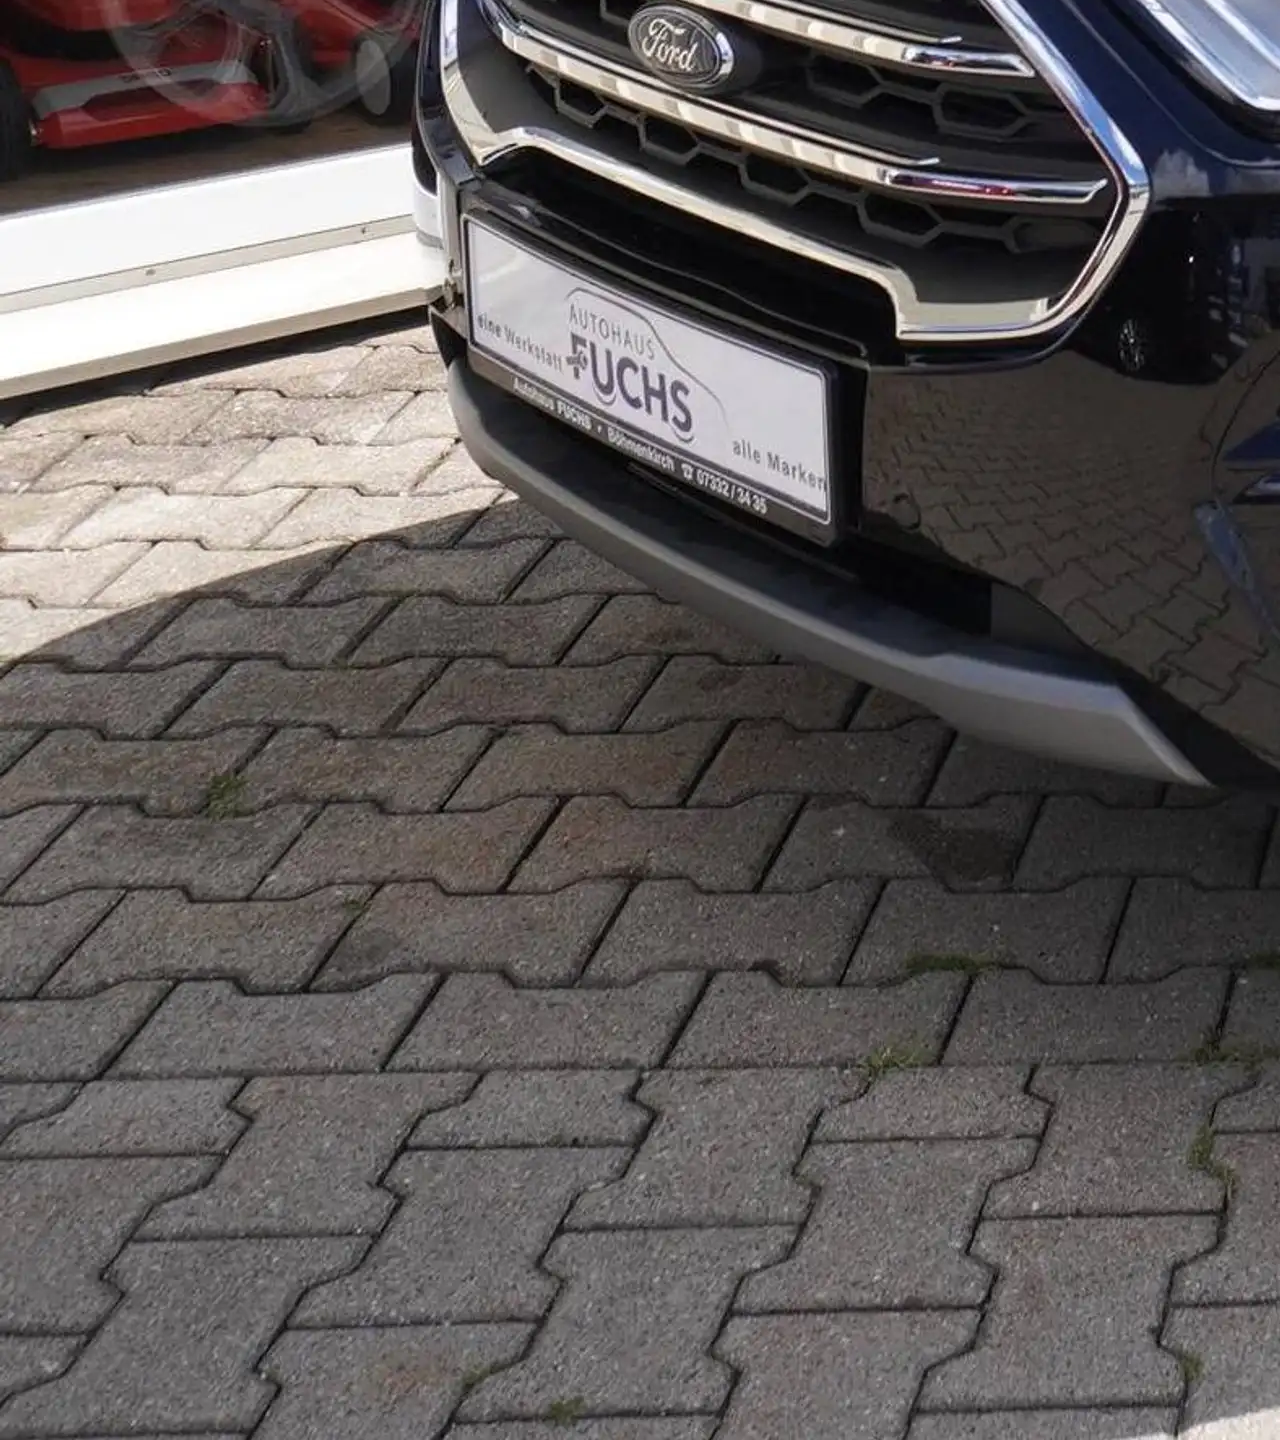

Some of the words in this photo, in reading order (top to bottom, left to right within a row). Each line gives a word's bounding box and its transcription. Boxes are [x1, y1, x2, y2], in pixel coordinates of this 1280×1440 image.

[642, 18, 698, 71] Ford
[569, 303, 654, 360] AUTOHAUS
[566, 332, 693, 434] FUCHS
[733, 440, 760, 464] alle
